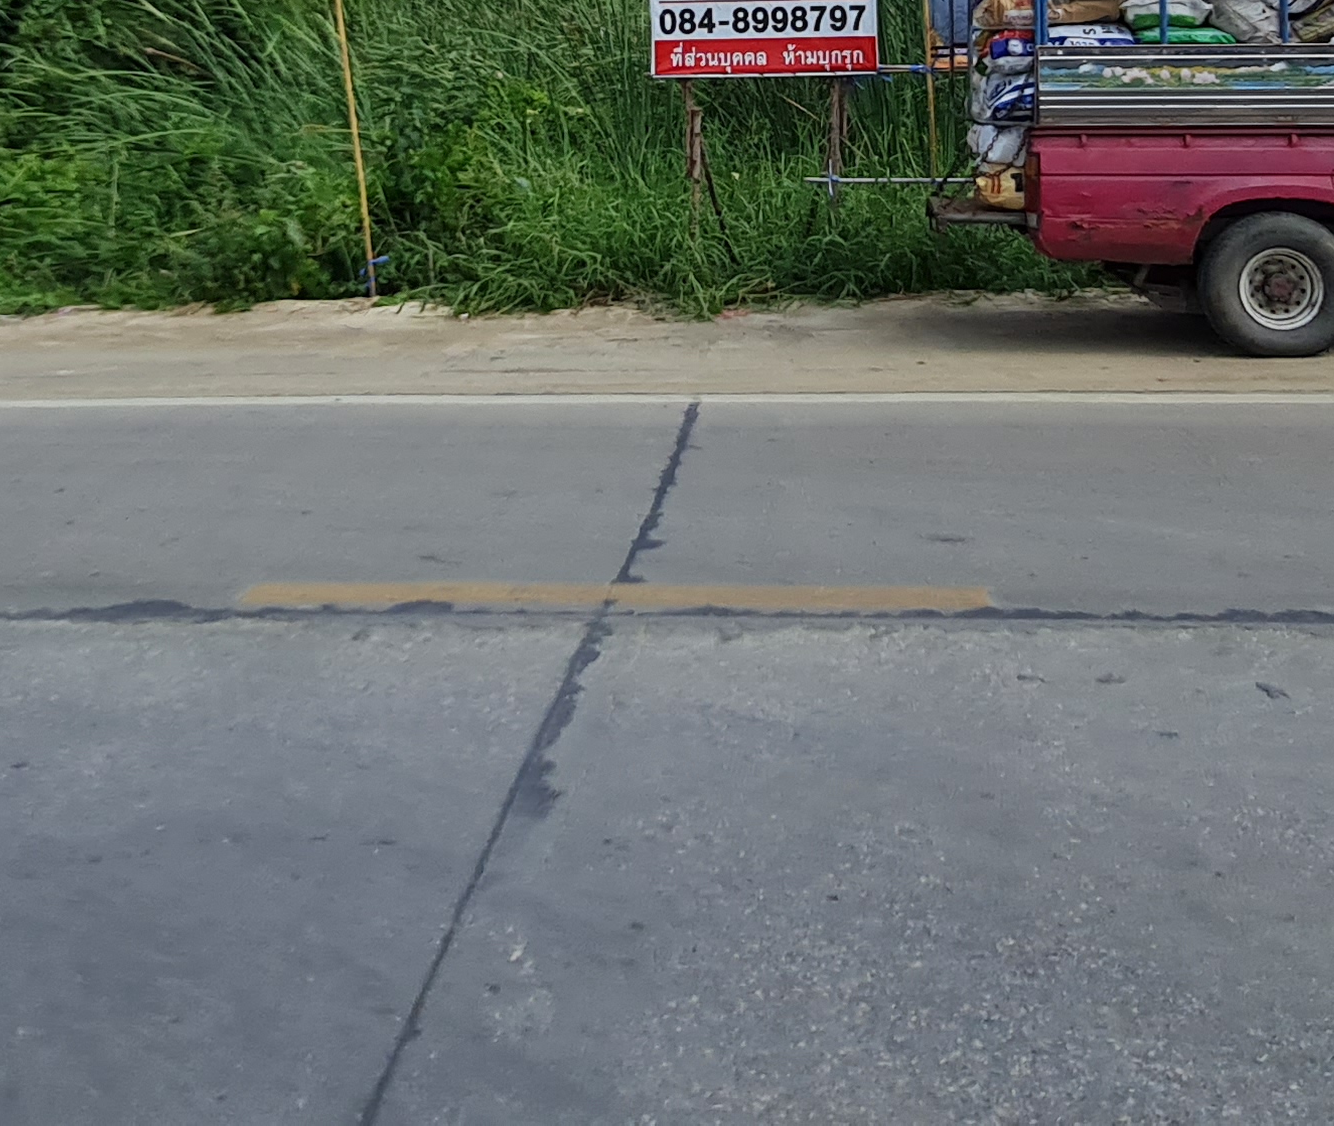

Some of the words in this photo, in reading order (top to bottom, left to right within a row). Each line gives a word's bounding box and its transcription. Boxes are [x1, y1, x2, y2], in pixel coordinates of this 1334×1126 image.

[659, 5, 866, 35] 084-8998797
[670, 42, 768, 73] ที่ส่วนบุคคล
[782, 43, 865, 71] ห้ามบุกรุก
